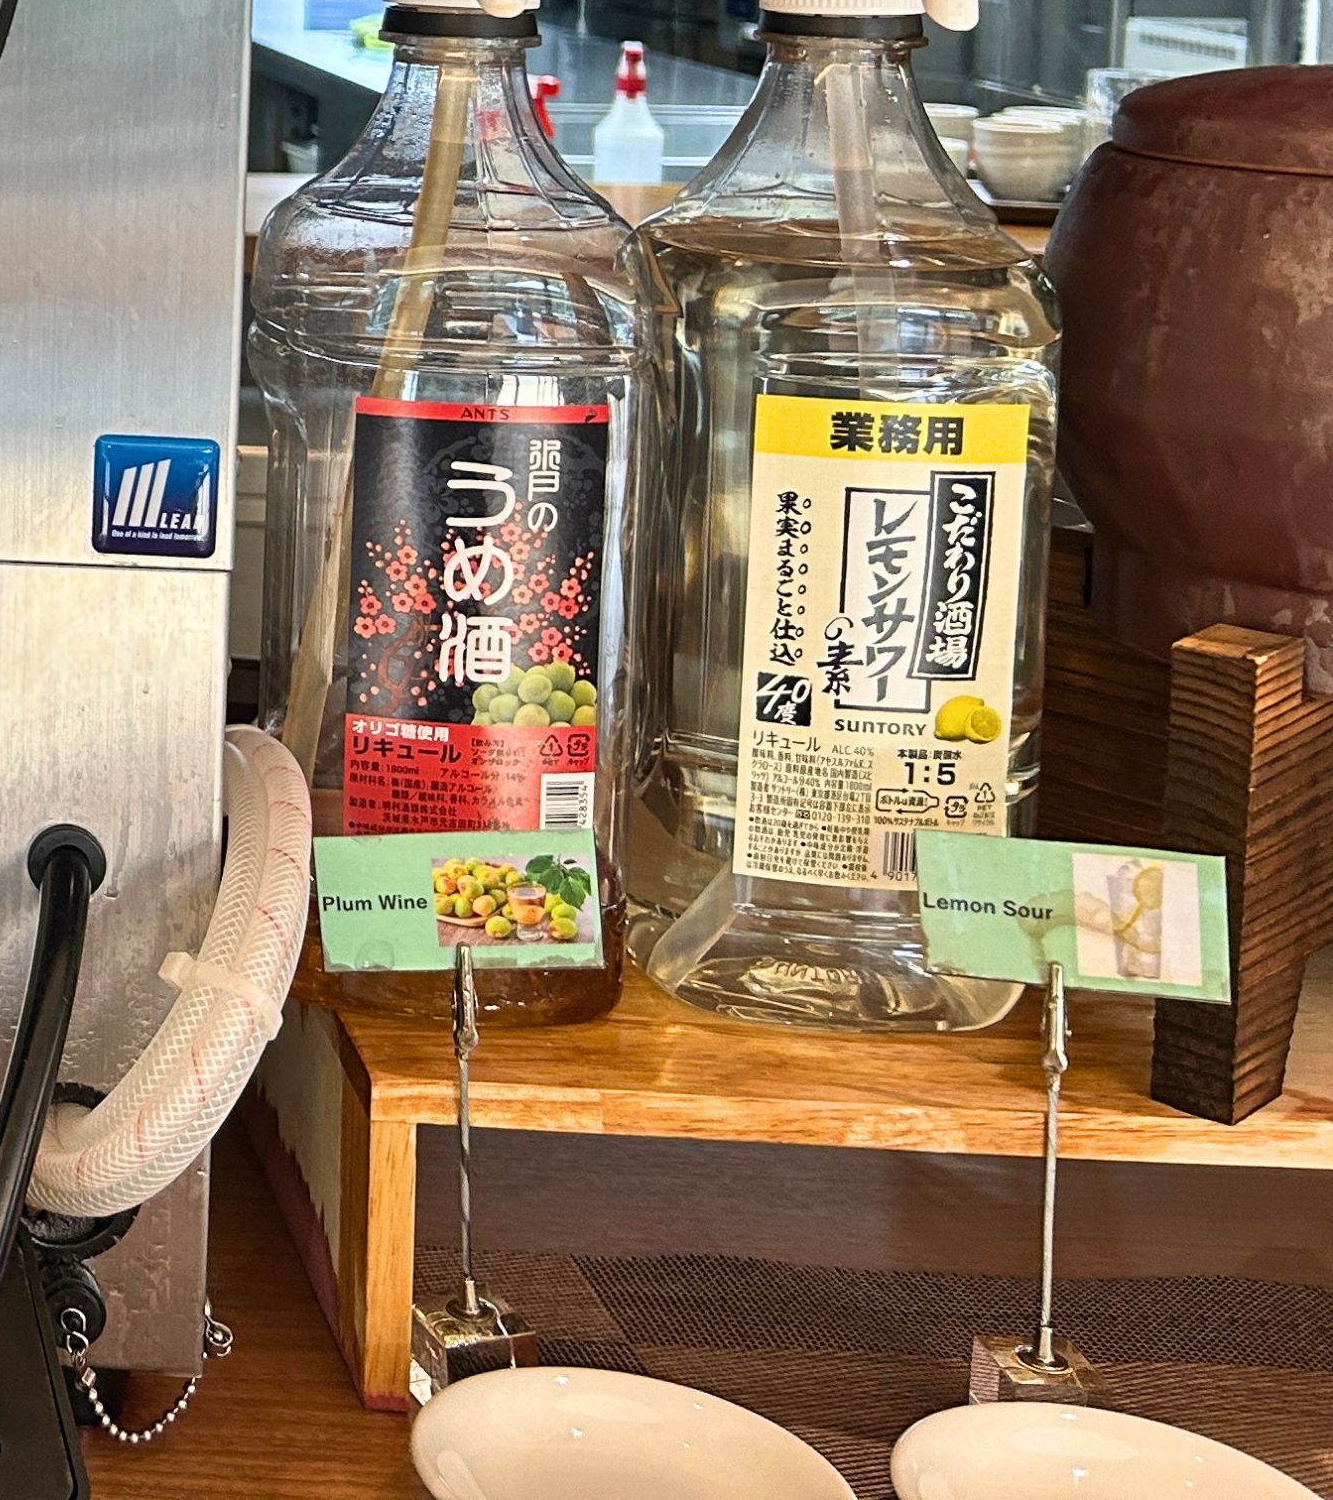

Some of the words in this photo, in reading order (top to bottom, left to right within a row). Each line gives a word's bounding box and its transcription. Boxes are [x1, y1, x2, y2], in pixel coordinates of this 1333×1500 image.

[830, 411, 965, 457] 業務用
[439, 461, 516, 684] うめ酒
[925, 481, 981, 669] こだわり酒場
[860, 497, 921, 703] レモンサワー
[816, 615, 864, 696] の素
[352, 719, 450, 742] オリゴ糖使用
[752, 730, 822, 753] リキュール
[834, 718, 927, 738] SUNTORY
[352, 736, 462, 764] リキュール
[904, 762, 956, 785] 1:5
[323, 895, 373, 912] Plum
[379, 894, 428, 911] Wine
[923, 892, 996, 916] Lemon
[1003, 900, 1054, 921] Sour
